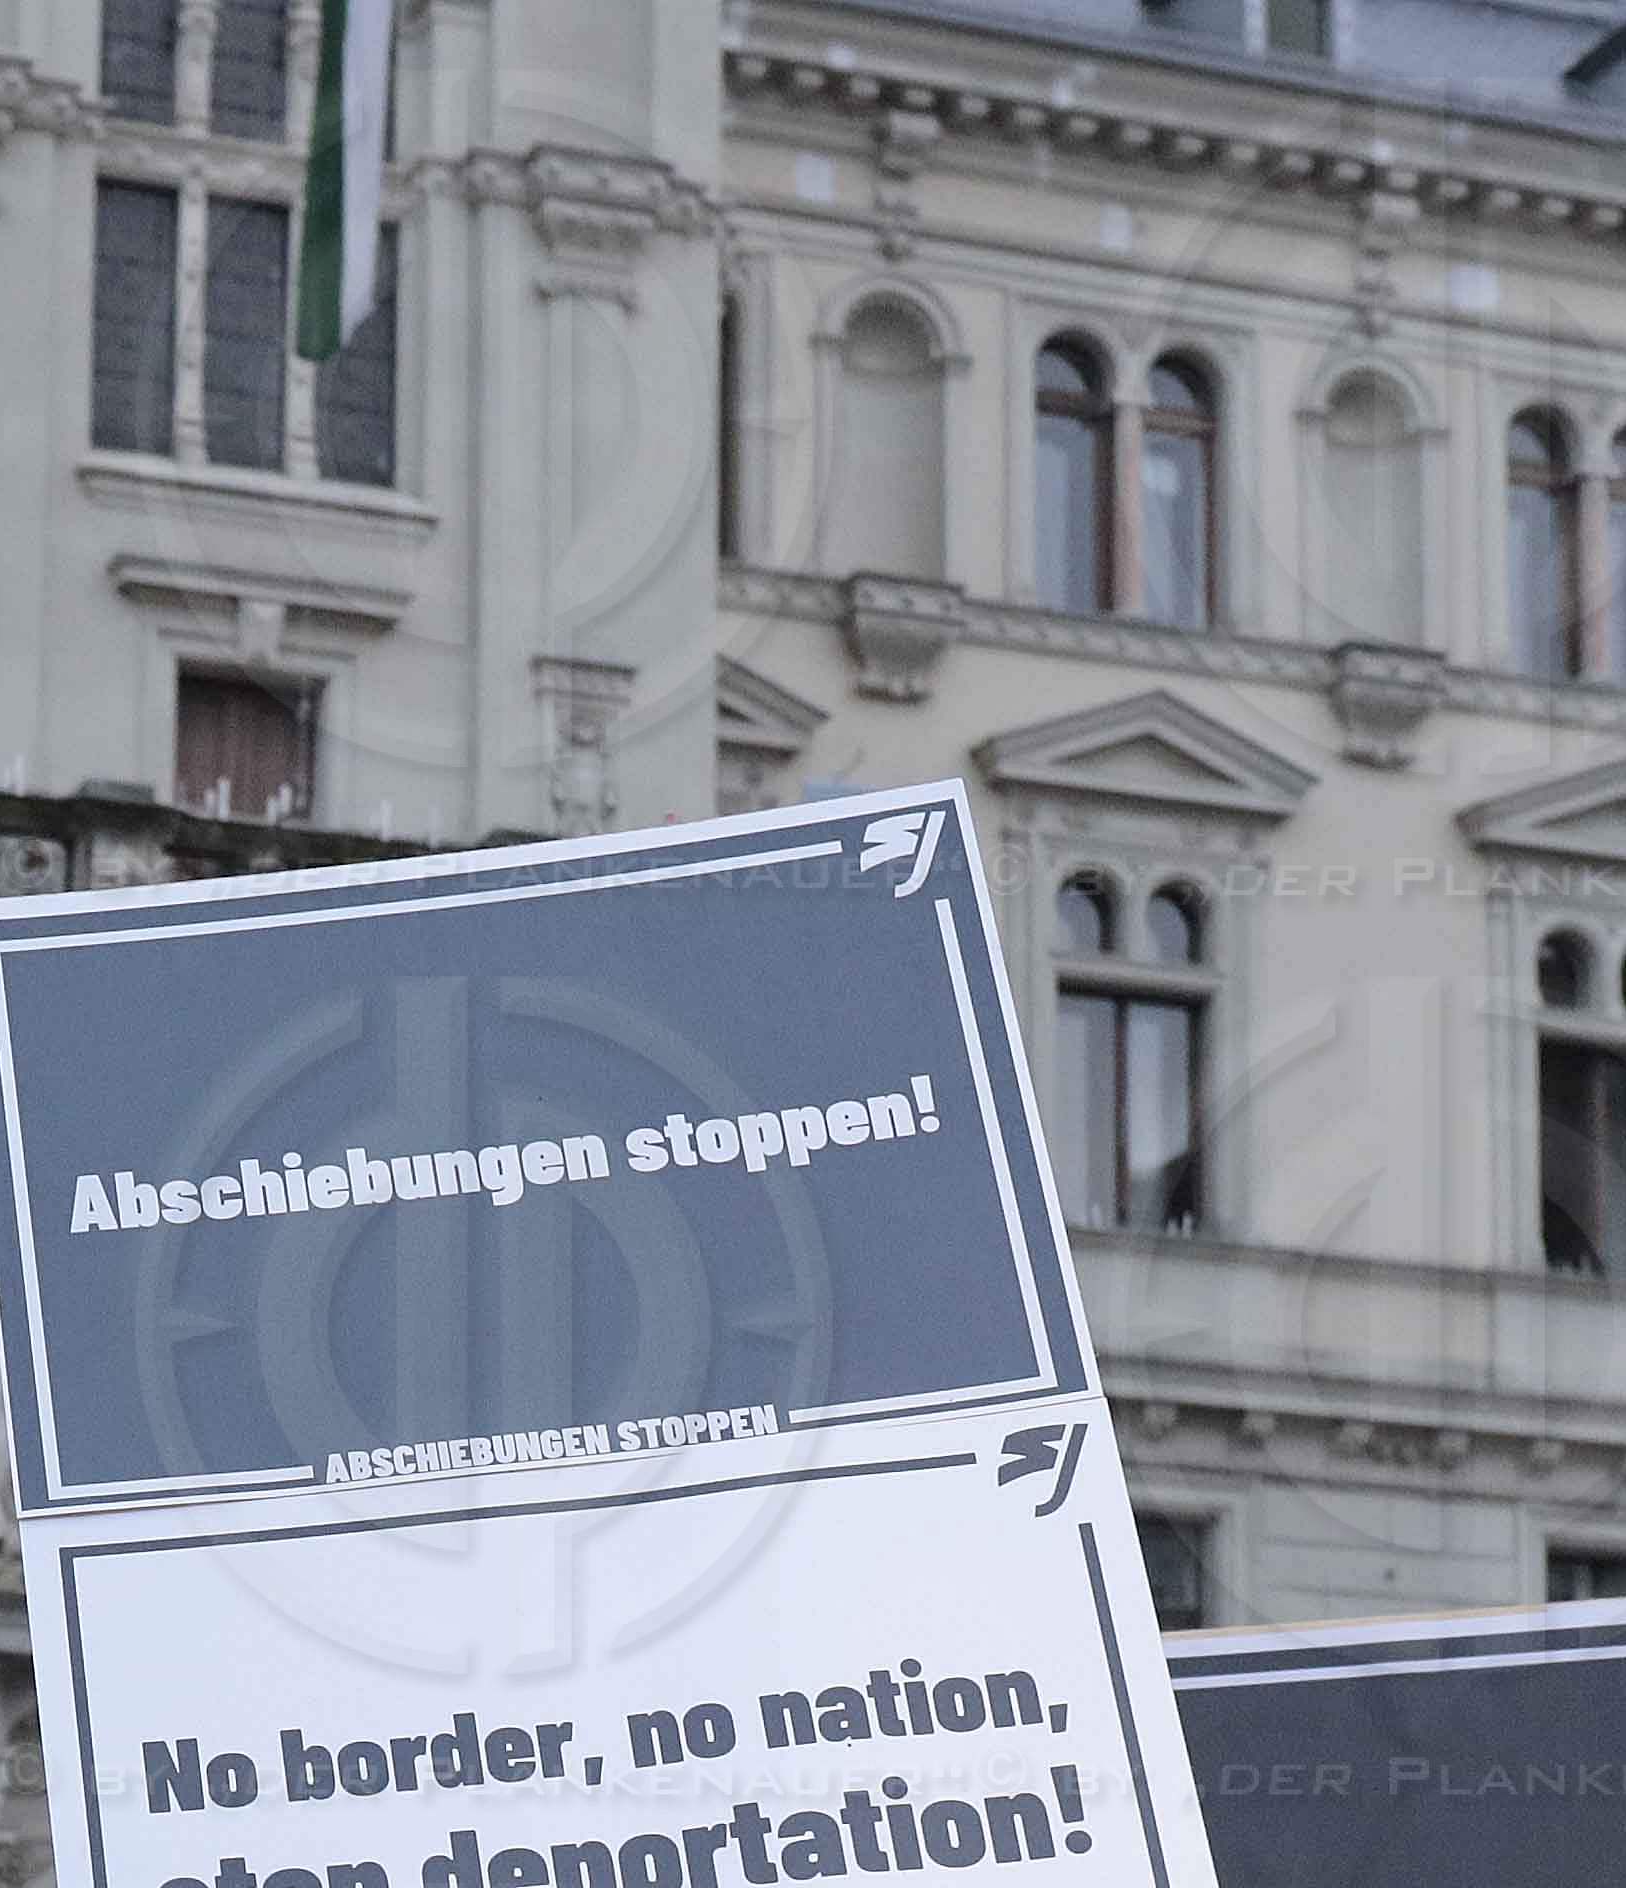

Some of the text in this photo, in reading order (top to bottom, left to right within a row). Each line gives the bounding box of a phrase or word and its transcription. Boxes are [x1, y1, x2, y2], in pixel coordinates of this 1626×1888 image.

[71, 1075, 939, 1233] Abschiebungen stoppen!
[327, 1405, 778, 1483] ABSCHIEBUNGEN STOPPEN
[142, 1658, 1068, 1814] No border, no nation,
